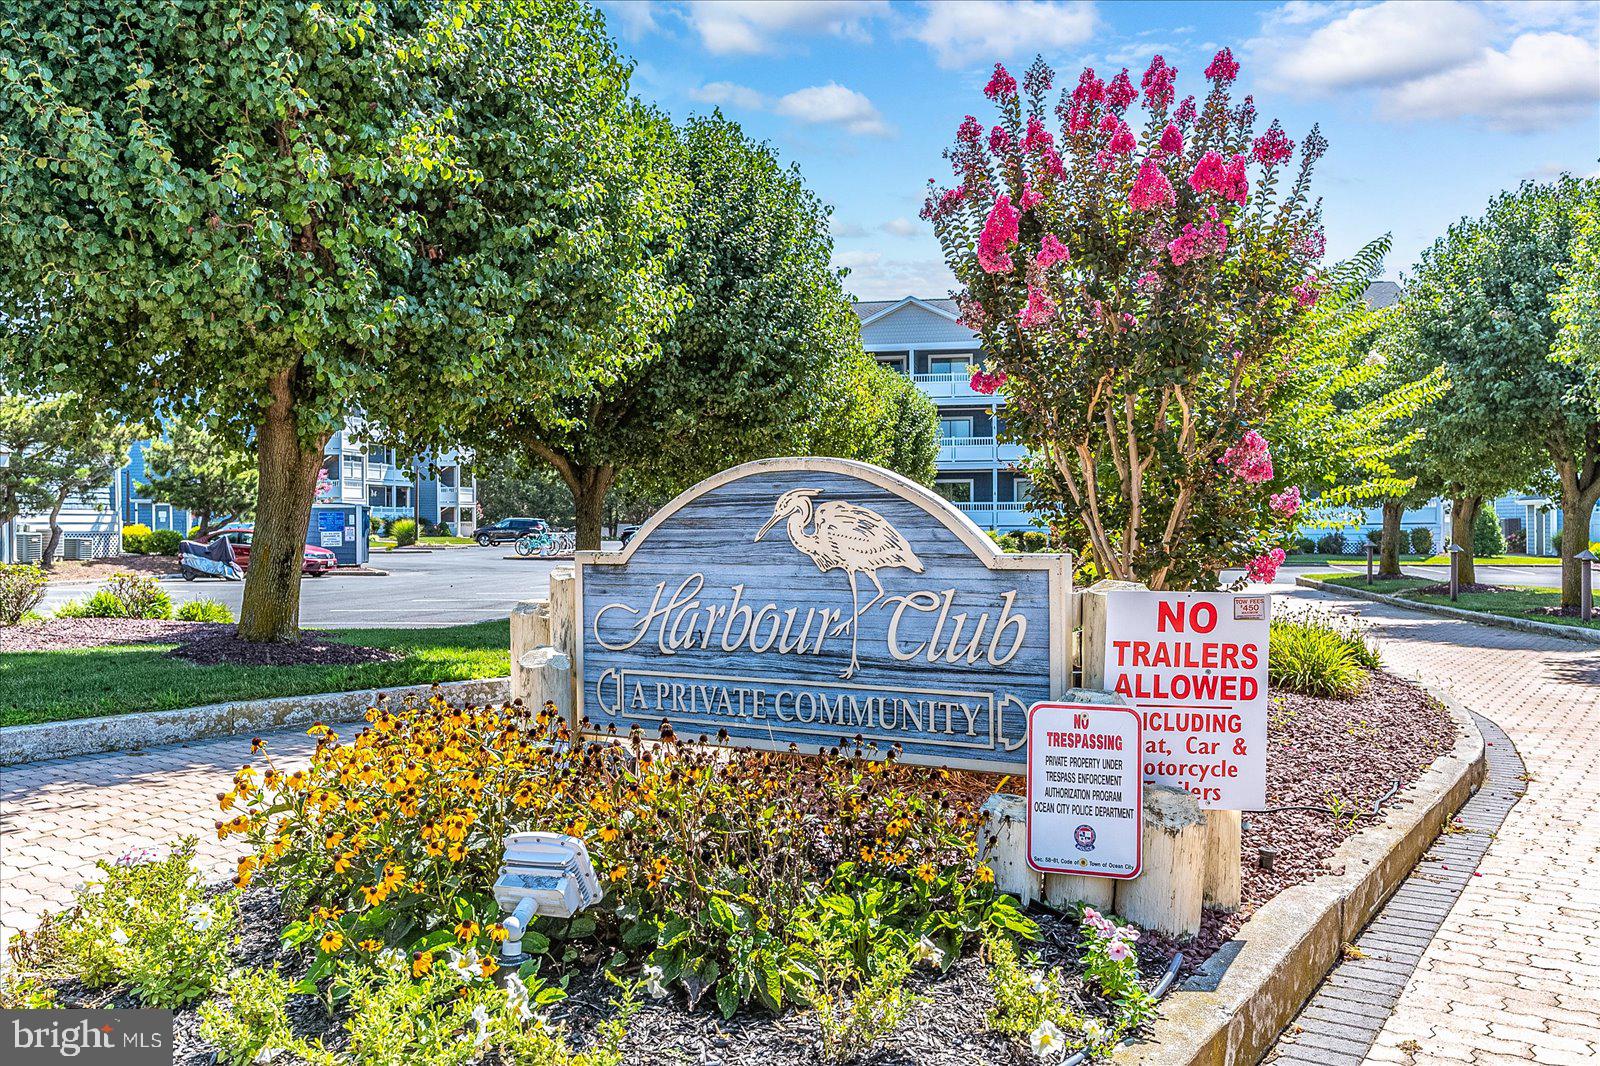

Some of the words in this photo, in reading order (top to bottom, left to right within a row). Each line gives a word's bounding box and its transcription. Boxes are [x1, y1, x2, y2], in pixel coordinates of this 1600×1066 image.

[594, 573, 840, 655] Harbour
[881, 588, 1027, 666] Club
[1157, 601, 1218, 634] NO
[1113, 641, 1258, 670] TRAILERS
[1114, 674, 1258, 701] ALLOWED
[631, 681, 648, 709] A
[655, 682, 766, 718] PRIVATE
[775, 690, 982, 736] COMMUNITY
[1074, 714, 1089, 730] NO
[1047, 732, 1122, 750] TRESPASSING
[1145, 738, 1172, 756] at,
[1186, 736, 1220, 754] Car
[1232, 738, 1247, 756] &
[1045, 756, 1068, 767] PRIVATE
[1070, 757, 1100, 768] PROPERTY
[1102, 758, 1122, 770] UNDER
[1144, 760, 1238, 782] otorcycle
[1046, 771, 1076, 784] TRESPASS
[1078, 774, 1122, 786] ENFORCEMENT
[1045, 787, 1090, 800] AUTHORIZATION
[1092, 790, 1122, 802] PROGRAM
[1034, 802, 1054, 813] OCEAN
[1056, 803, 1070, 814] CITY
[1072, 804, 1092, 816] POLICE
[1095, 806, 1134, 818] DEPARTMENT
